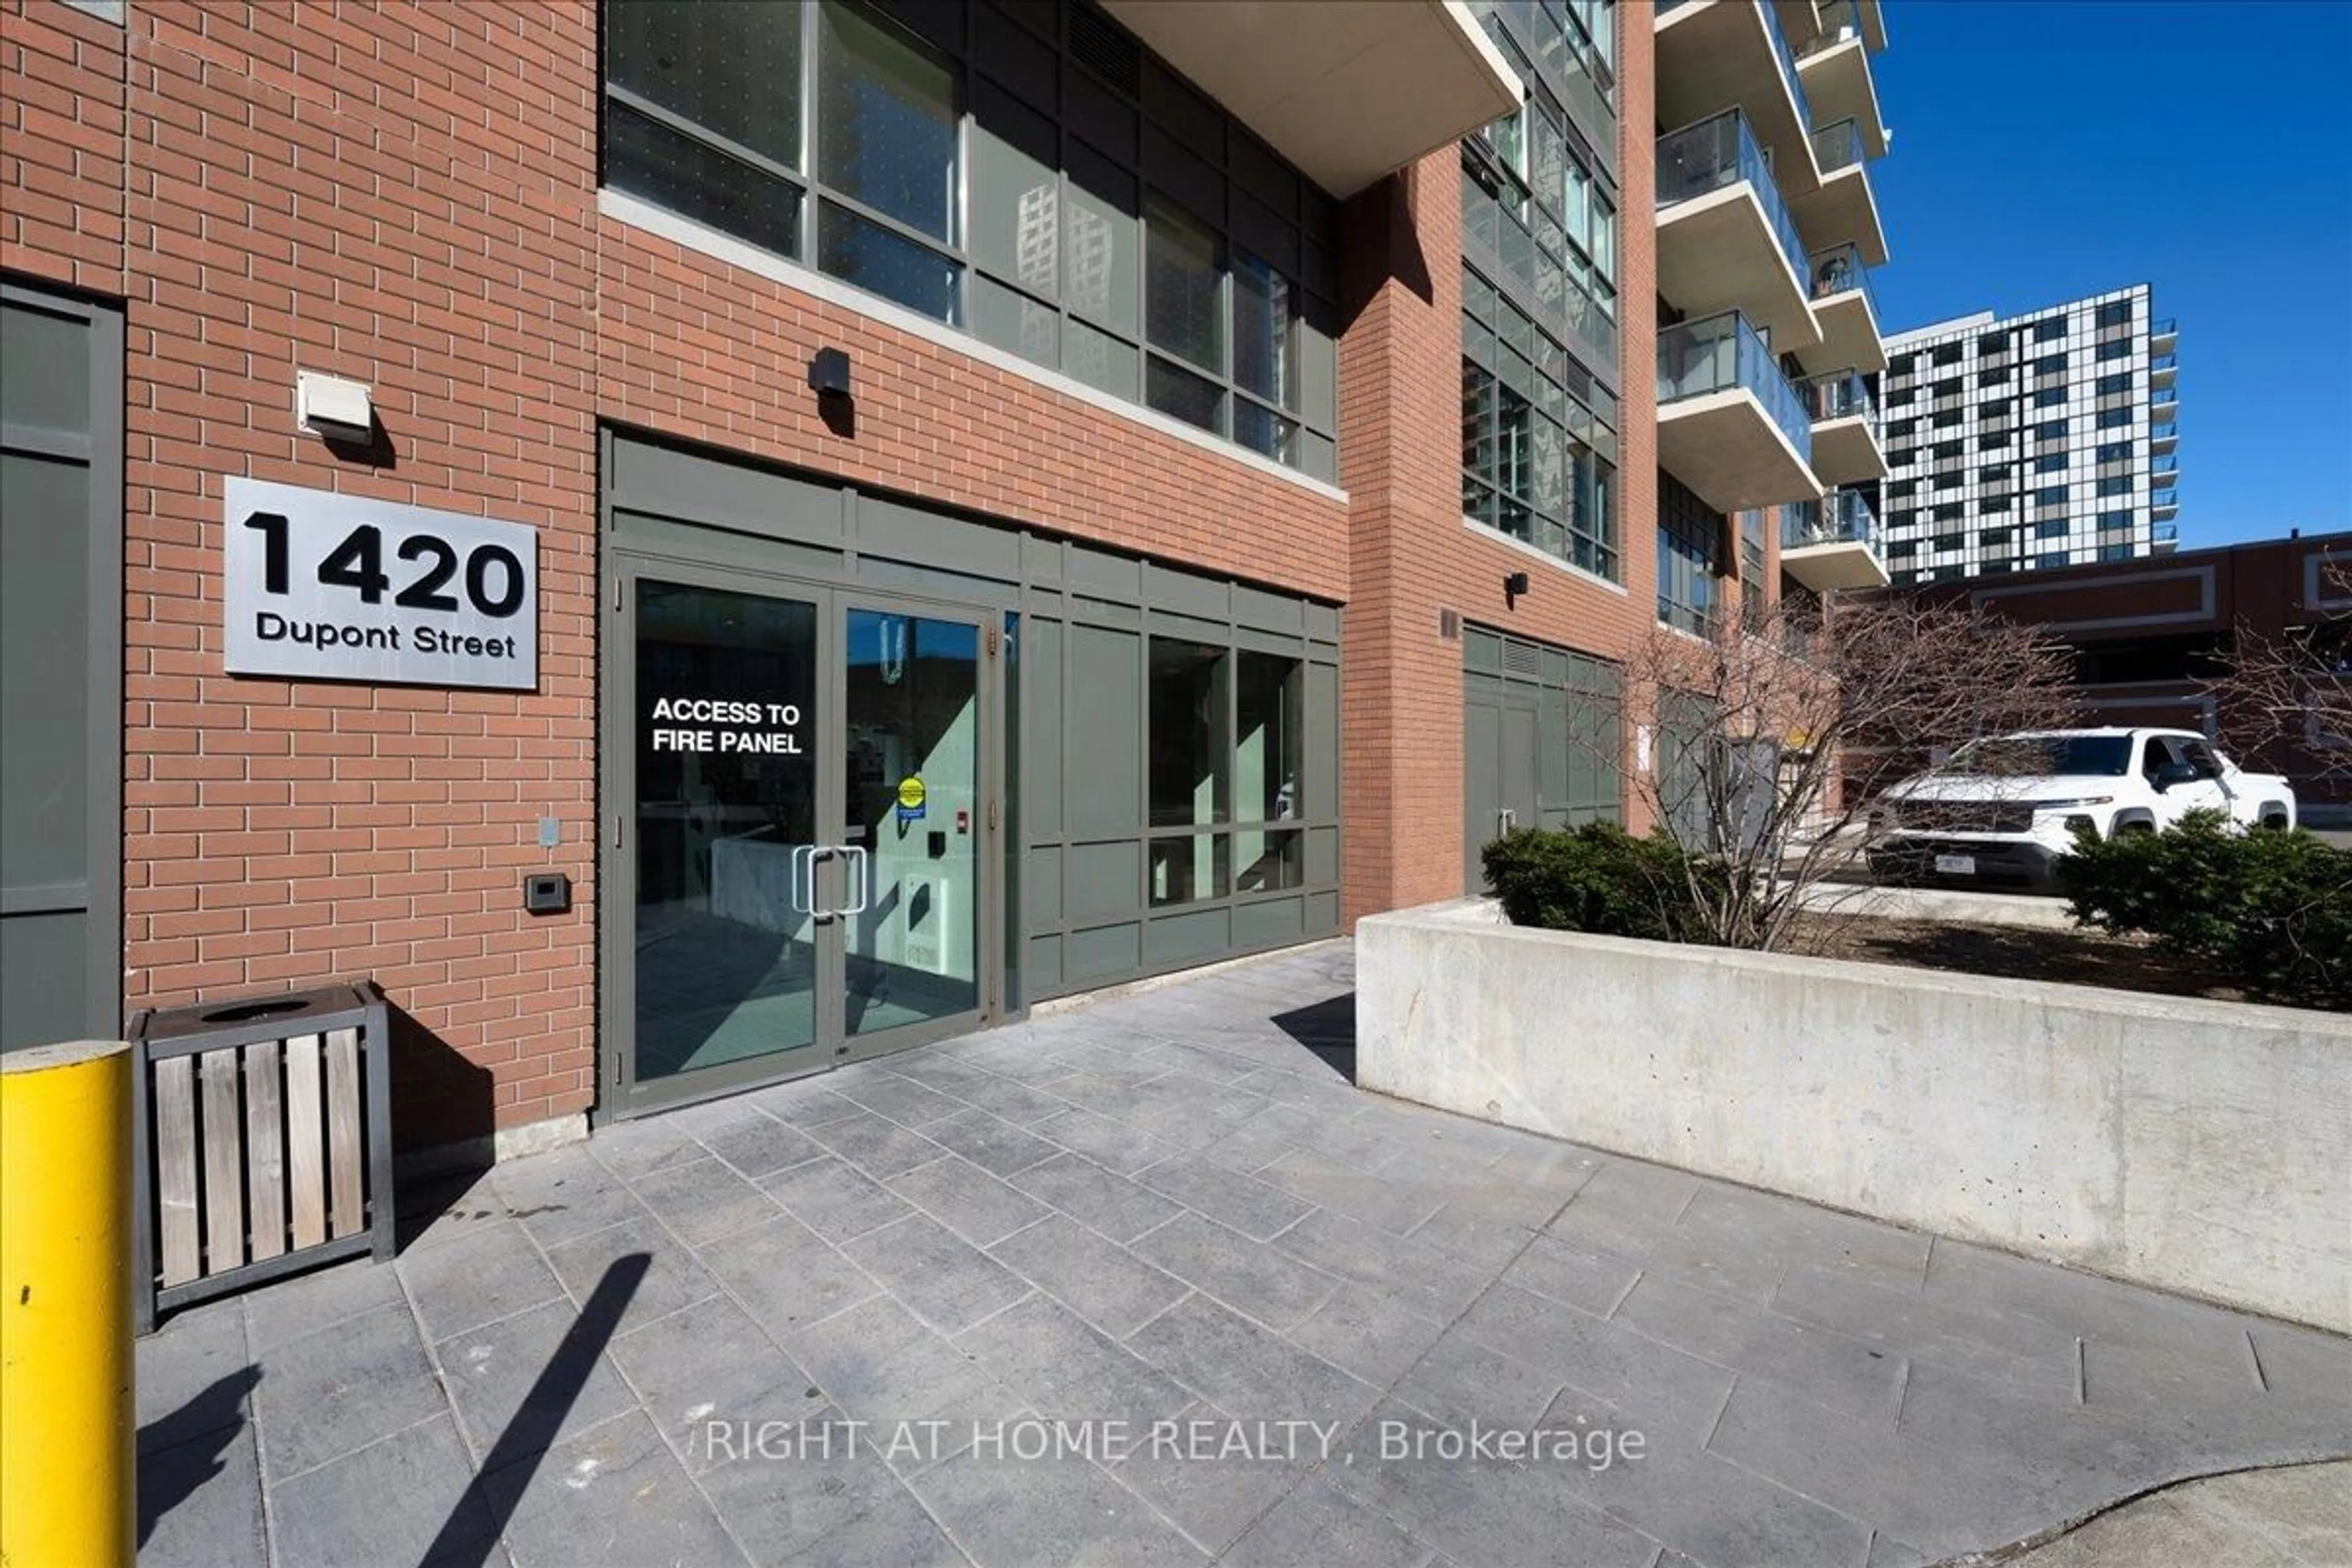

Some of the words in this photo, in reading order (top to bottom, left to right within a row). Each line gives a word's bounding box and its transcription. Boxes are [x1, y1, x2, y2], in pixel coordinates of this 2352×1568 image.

[244, 511, 525, 618] 1420
[256, 612, 400, 650] Dupont
[413, 625, 516, 659] Street
[652, 697, 761, 725] ACCESS
[766, 704, 800, 725] TO
[653, 729, 714, 752] FIRE
[720, 731, 802, 754] PANEL
